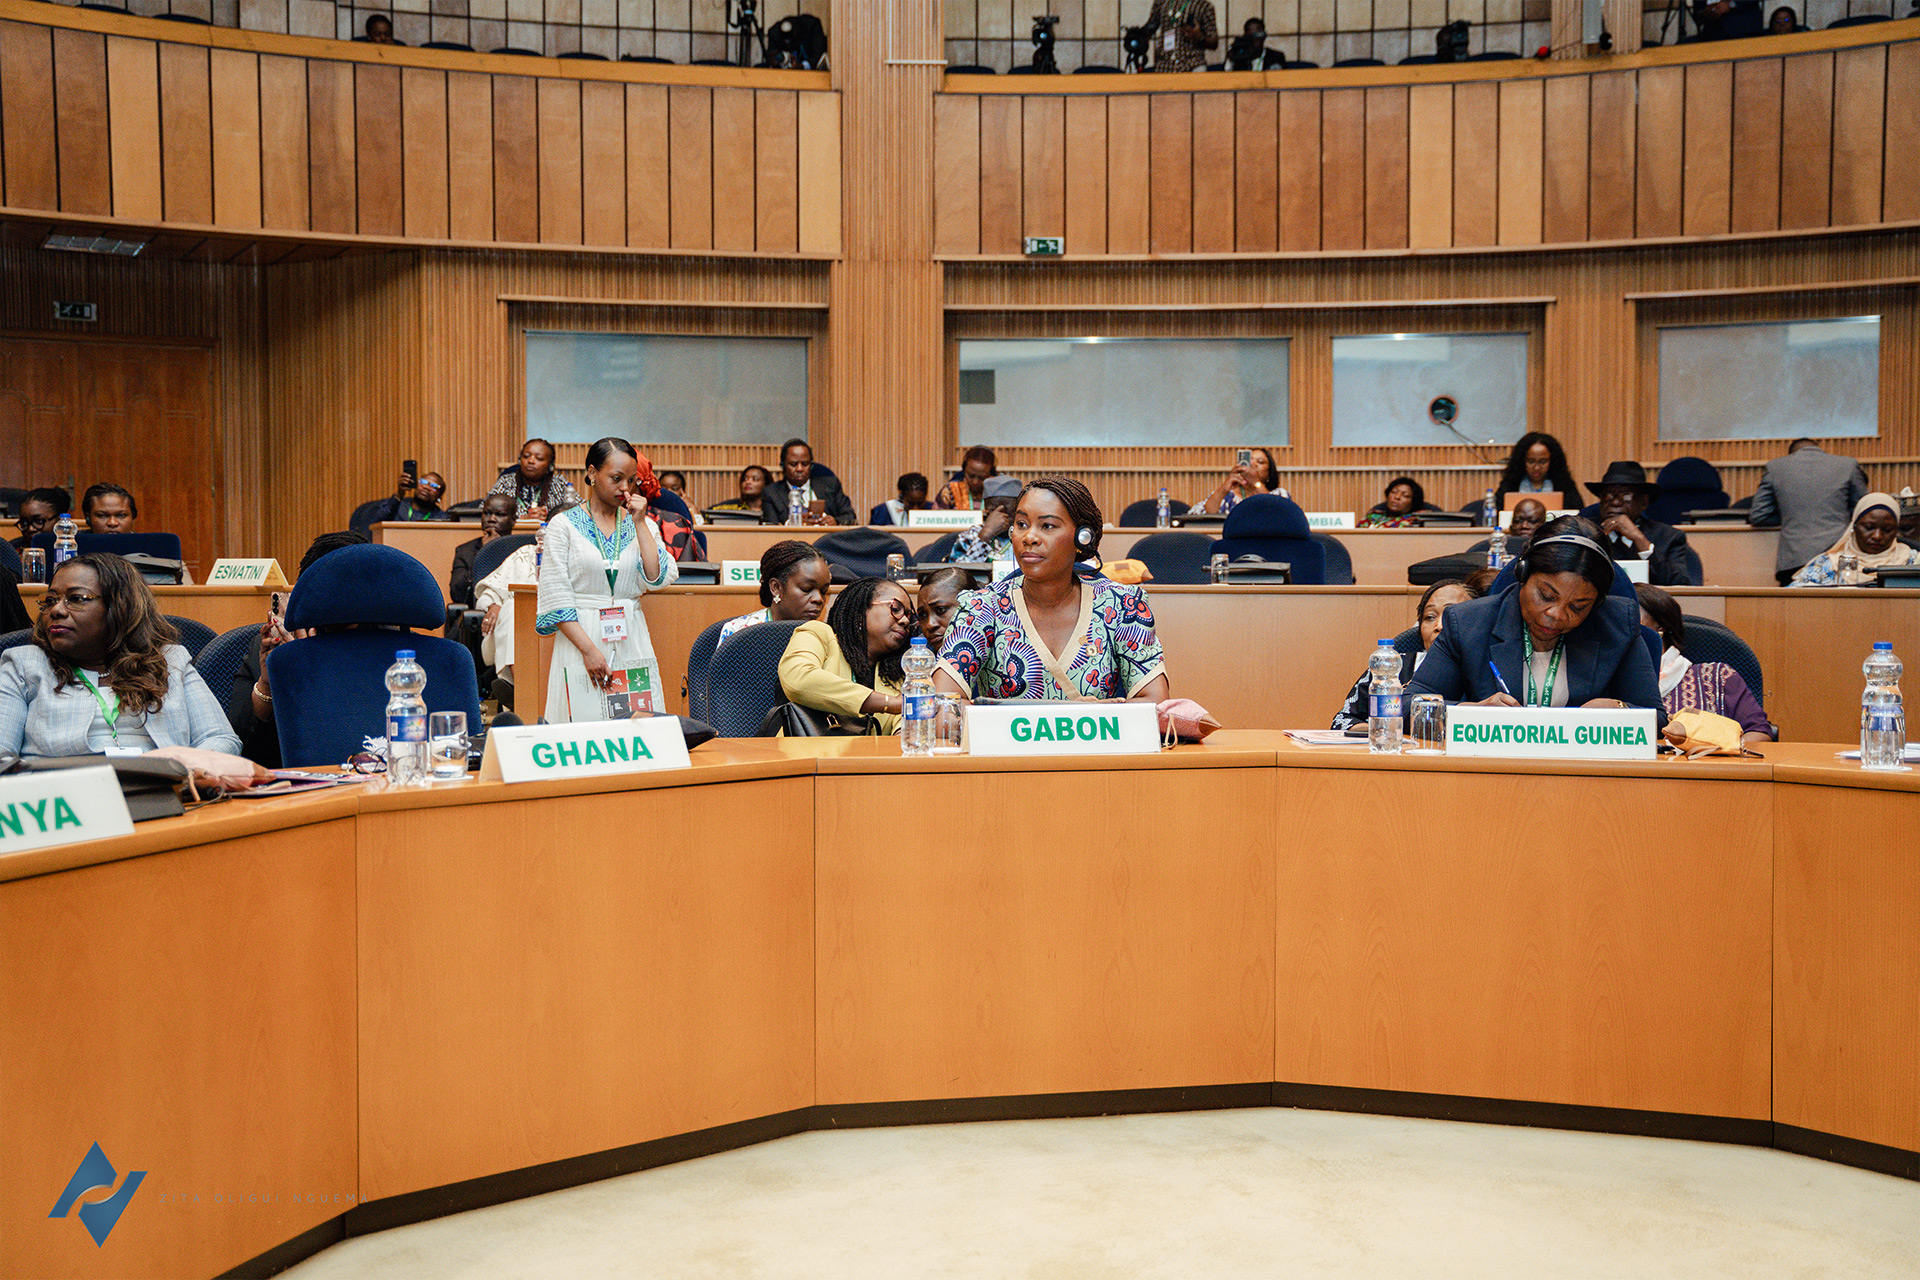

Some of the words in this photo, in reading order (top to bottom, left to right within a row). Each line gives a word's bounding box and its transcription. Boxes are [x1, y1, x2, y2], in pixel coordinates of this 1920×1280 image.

[915, 516, 976, 525] ZIMBABWE
[214, 565, 265, 580] ESWATINI
[1010, 716, 1120, 742] GABON
[1453, 723, 1569, 744] EQUATORIAL
[1574, 725, 1648, 745] GUINEA
[531, 736, 654, 768] GHANA
